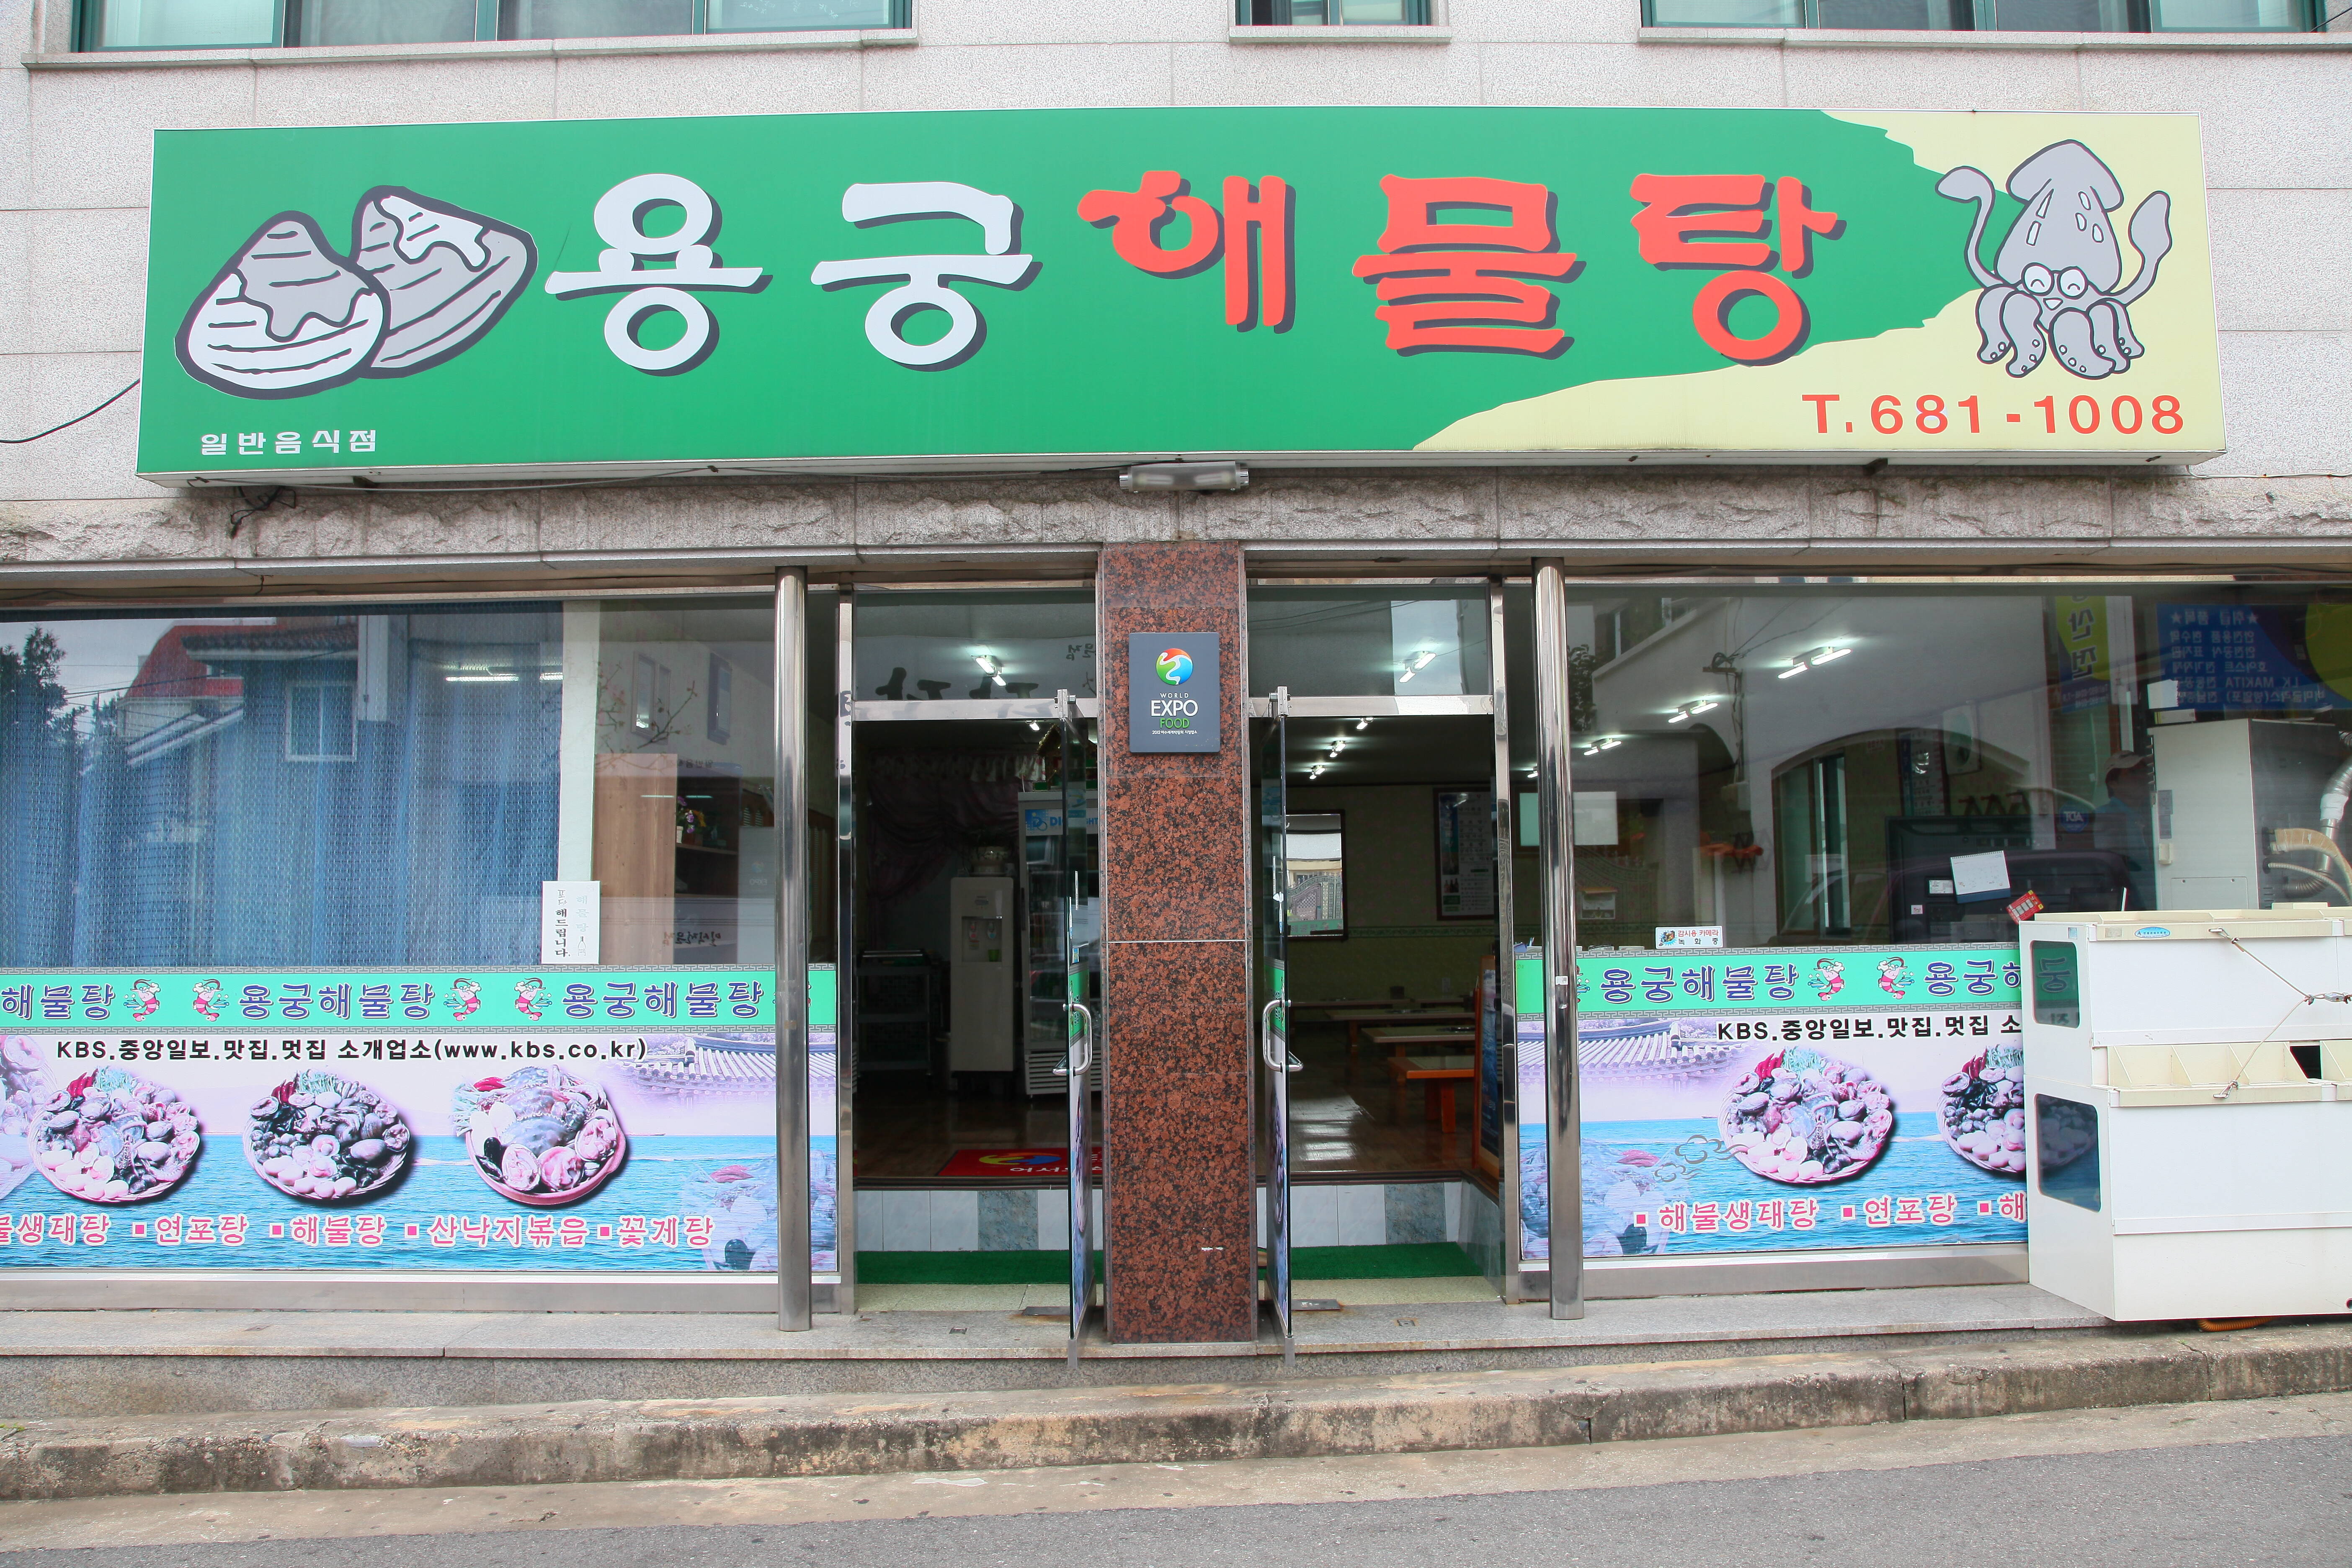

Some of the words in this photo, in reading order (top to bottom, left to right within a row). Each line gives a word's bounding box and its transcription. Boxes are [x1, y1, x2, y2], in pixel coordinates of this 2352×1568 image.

[200, 429, 376, 455] 일반음식점
[1151, 700, 1198, 717] EXPO
[1160, 718, 1189, 728] FOOD
[1600, 962, 1799, 1003] 용궁해물탕
[238, 983, 435, 1020] 용궁해물탕
[562, 980, 764, 1019] 용궁해물탕
[1660, 1198, 1818, 1233] 해물생태탕
[1864, 1194, 1957, 1227] 연포탕
[156, 1215, 247, 1245] 연포탕
[291, 1215, 385, 1246] 해물탕
[429, 1215, 588, 1247] 산낙지볶음
[618, 1215, 714, 1247] 꽃게탕
